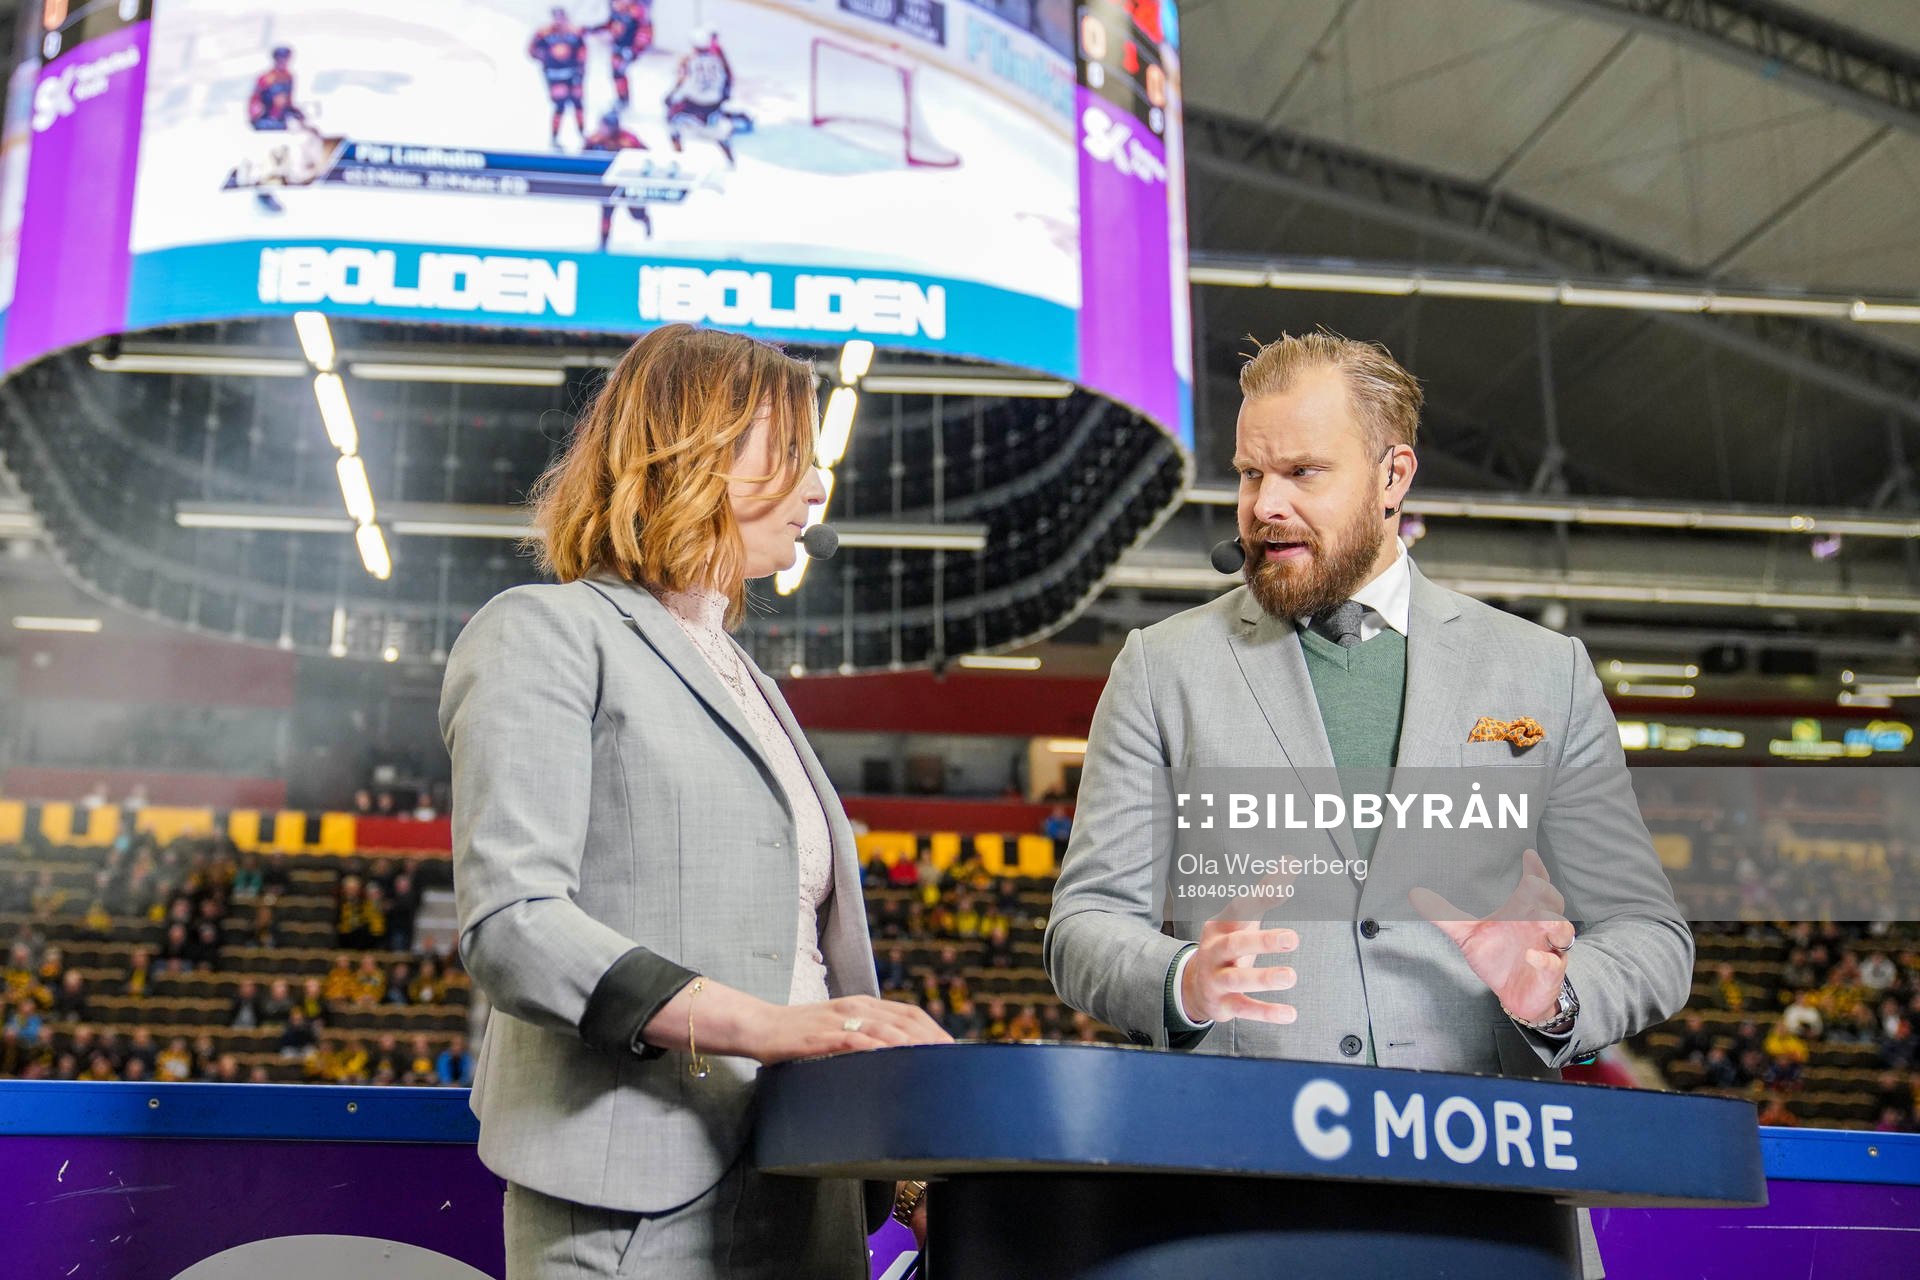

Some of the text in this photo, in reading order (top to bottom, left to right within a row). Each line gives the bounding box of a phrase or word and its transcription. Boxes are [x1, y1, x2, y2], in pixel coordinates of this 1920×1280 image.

[268, 247, 578, 317] BOLIDEN
[644, 265, 947, 340] BOLIDEN
[1292, 1078, 1578, 1172] C MORE
